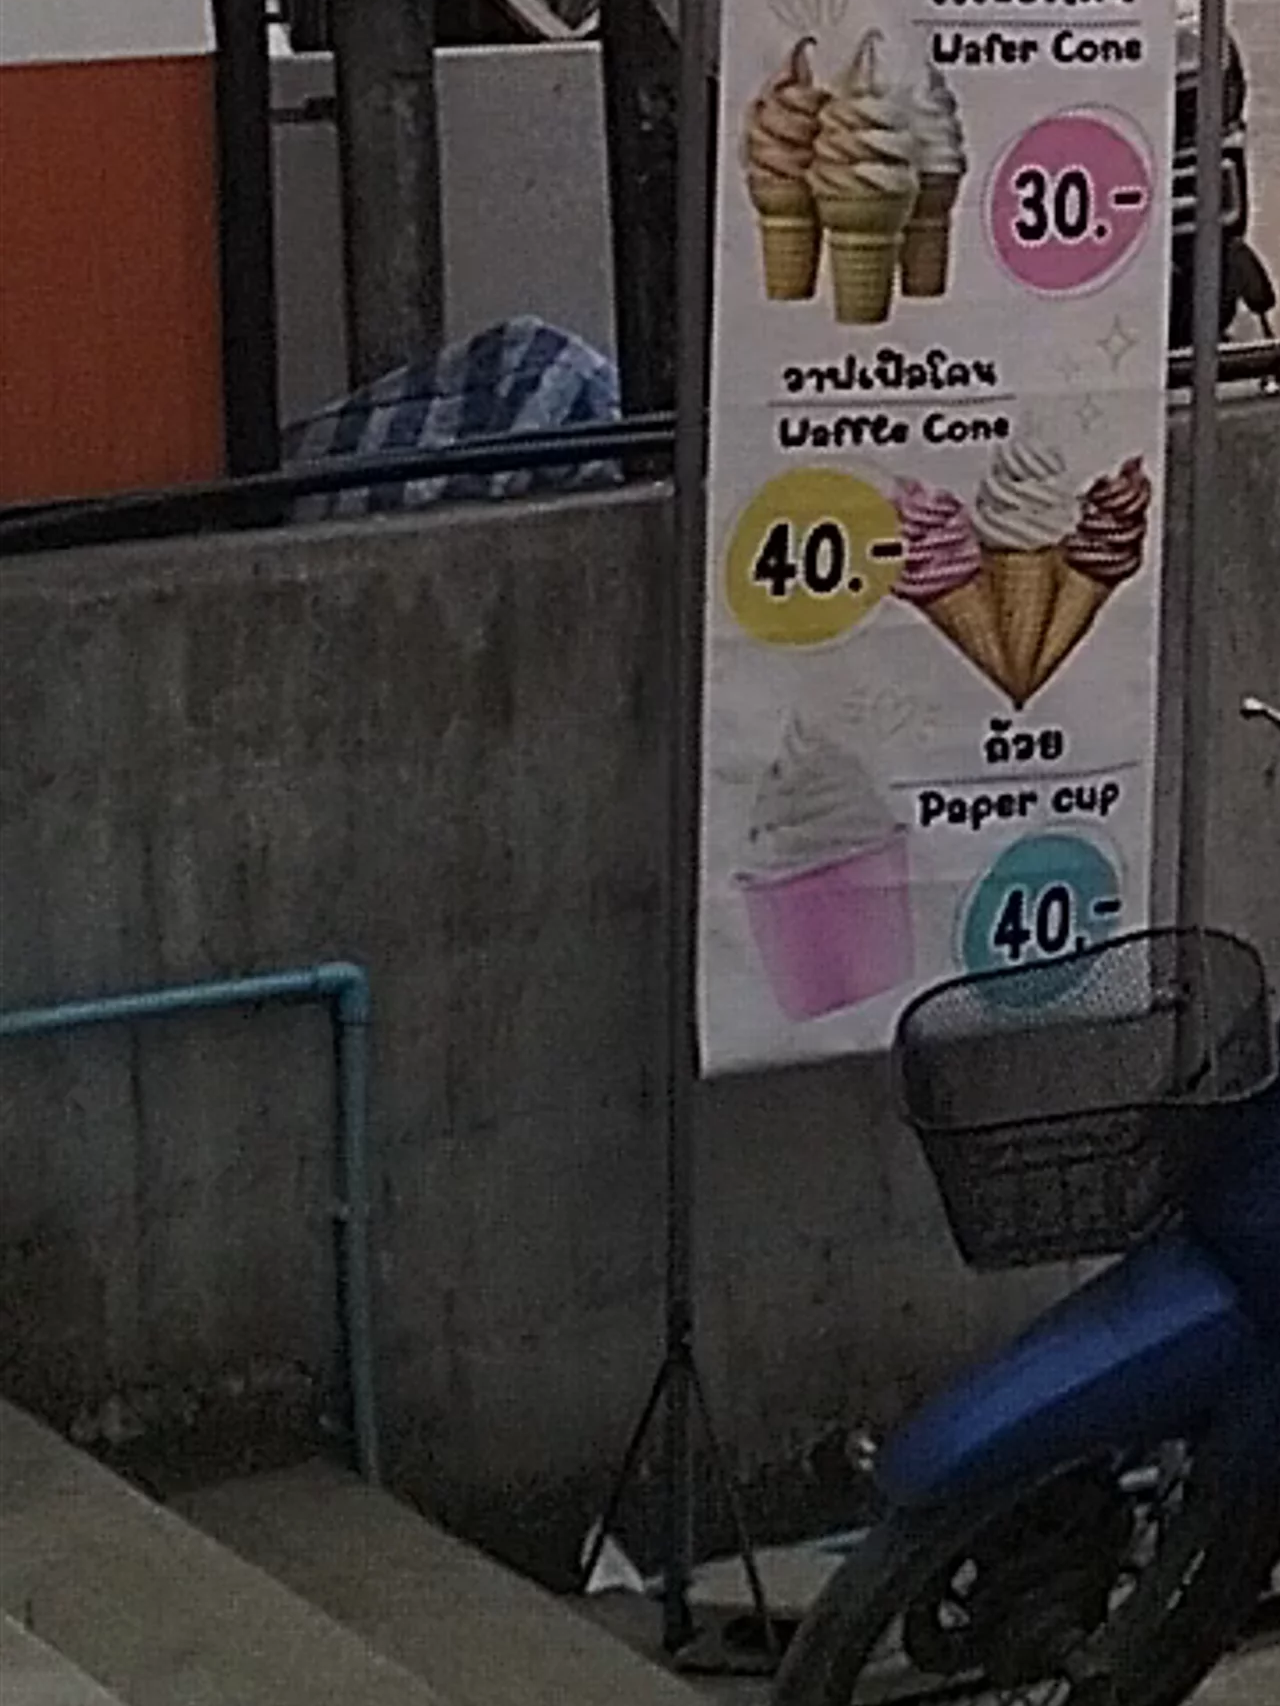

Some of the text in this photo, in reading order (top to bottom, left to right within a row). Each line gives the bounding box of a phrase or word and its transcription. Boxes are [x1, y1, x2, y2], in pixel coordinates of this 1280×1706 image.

[932, 29, 1142, 65] Wafer Cone
[1013, 169, 1142, 243] 30.-
[779, 412, 1010, 447] Waffle Cone
[754, 521, 904, 596] 40.-
[918, 782, 1121, 831] Paper cup
